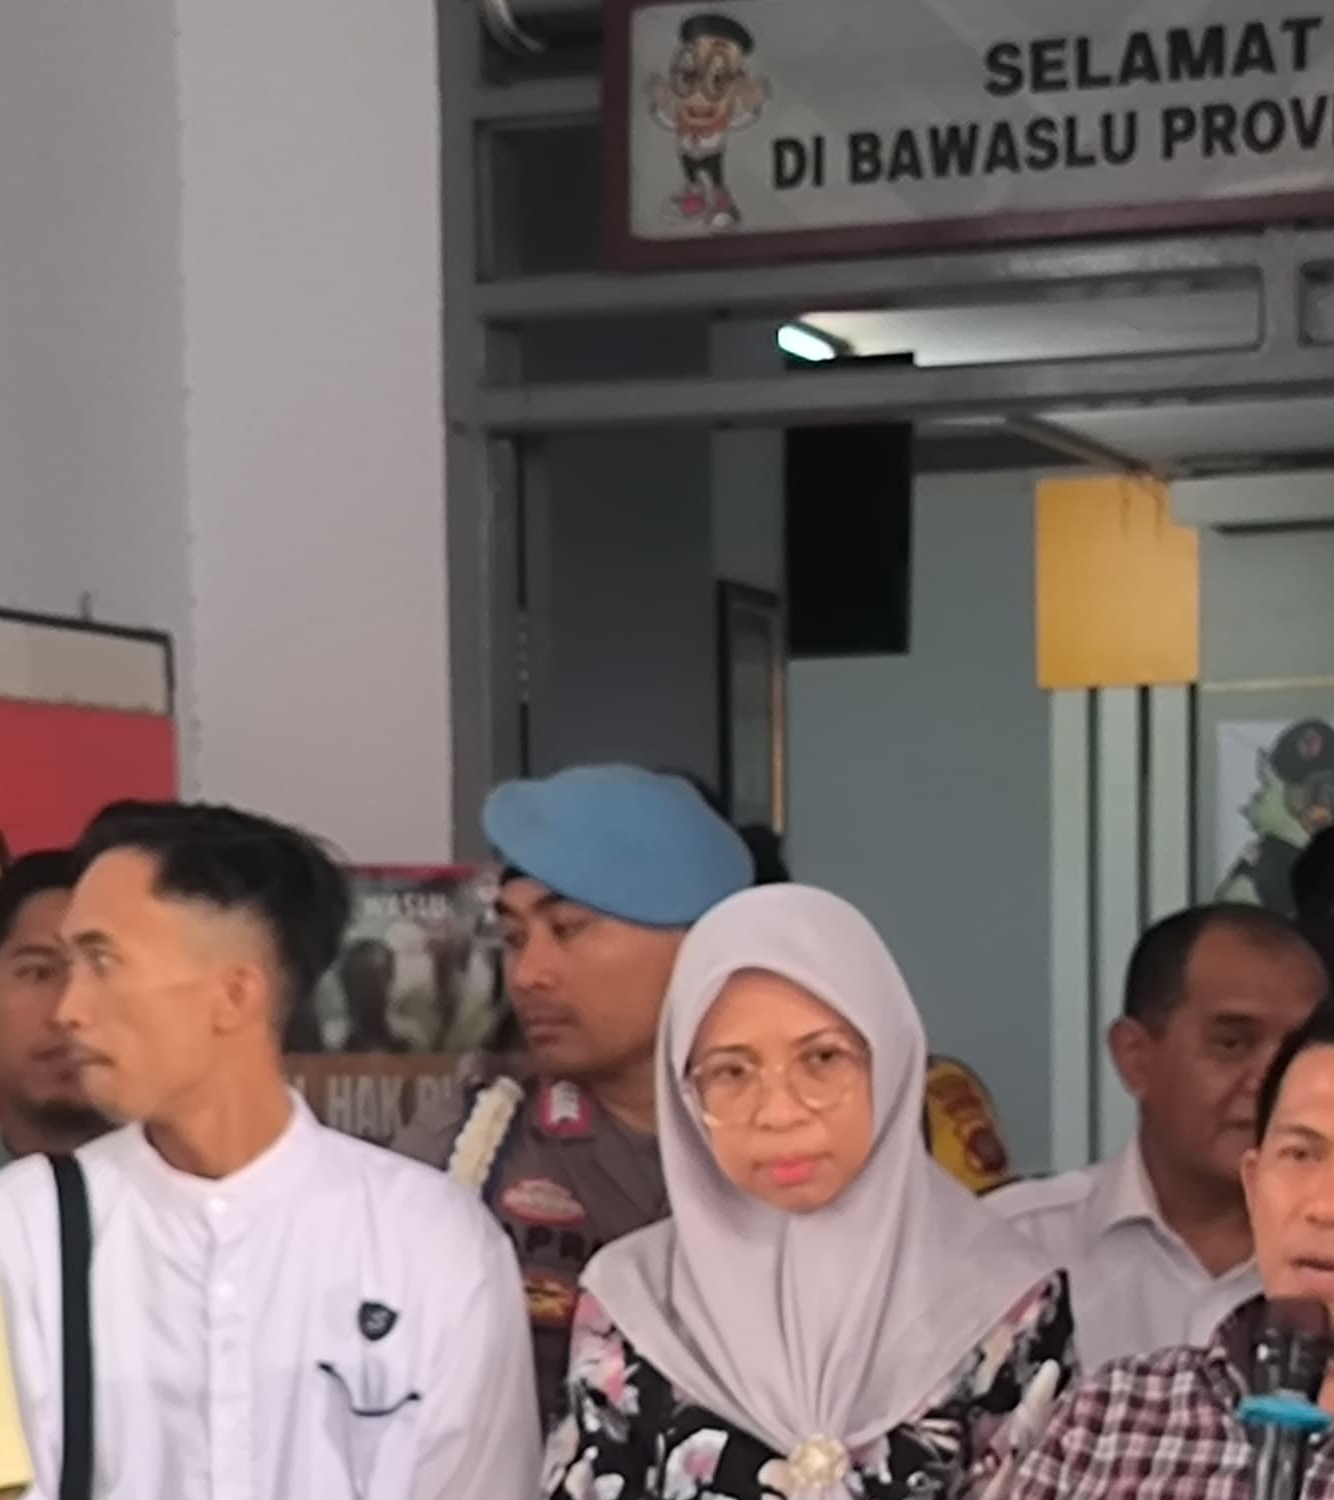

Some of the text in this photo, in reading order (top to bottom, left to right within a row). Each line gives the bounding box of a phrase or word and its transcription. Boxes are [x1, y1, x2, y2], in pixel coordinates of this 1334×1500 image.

[984, 17, 1323, 98] SELAMAT
[772, 134, 825, 191] DI
[847, 110, 1139, 185] BAWASLU
